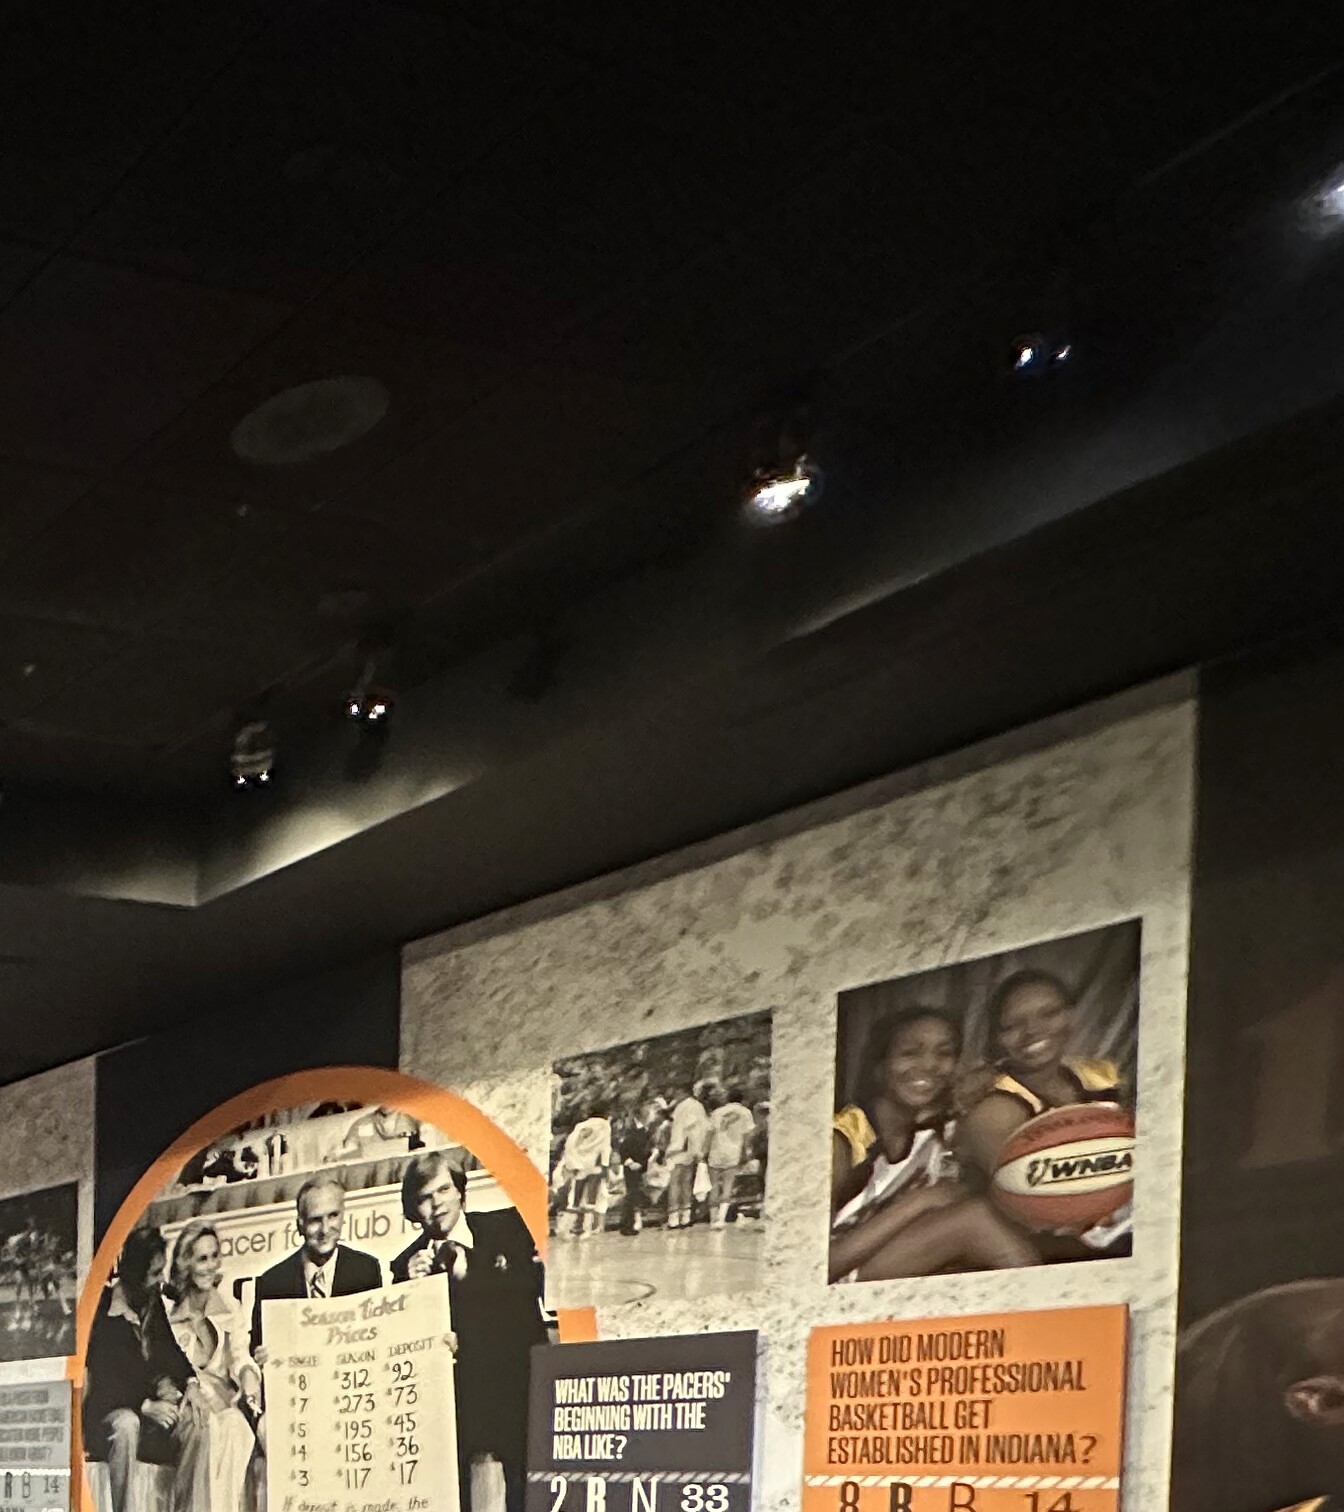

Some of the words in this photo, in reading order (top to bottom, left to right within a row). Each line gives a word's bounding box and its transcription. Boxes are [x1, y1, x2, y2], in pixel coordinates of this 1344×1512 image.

[1052, 1152, 1132, 1178] WNBA
[222, 1229, 275, 1256] acer
[300, 1306, 356, 1327] Season
[326, 1325, 378, 1345] Prices
[388, 1336, 434, 1358] DEPOSIT
[831, 1339, 874, 1367] HOW
[879, 1335, 911, 1364] DID
[916, 1328, 1005, 1361] MODERN
[555, 1378, 596, 1404] WHAT
[597, 1376, 630, 1402] WAS
[632, 1374, 662, 1401] THE
[663, 1371, 731, 1399] PACERS'
[830, 1367, 922, 1399] WOMEN'S
[926, 1360, 1086, 1396] PROFESSIONAL
[553, 1404, 630, 1432] BEGINNING
[633, 1404, 672, 1430] WITH
[674, 1402, 706, 1429] THE
[829, 1402, 949, 1432] BASKETBALL
[954, 1399, 993, 1429] GET
[553, 1434, 582, 1460] NBA
[584, 1434, 628, 1460] LIKE?
[828, 1435, 954, 1464] ESTABLISHED
[958, 1435, 980, 1463] IN
[985, 1433, 1098, 1464] INDIANA?
[408, 1495, 429, 1510] the
